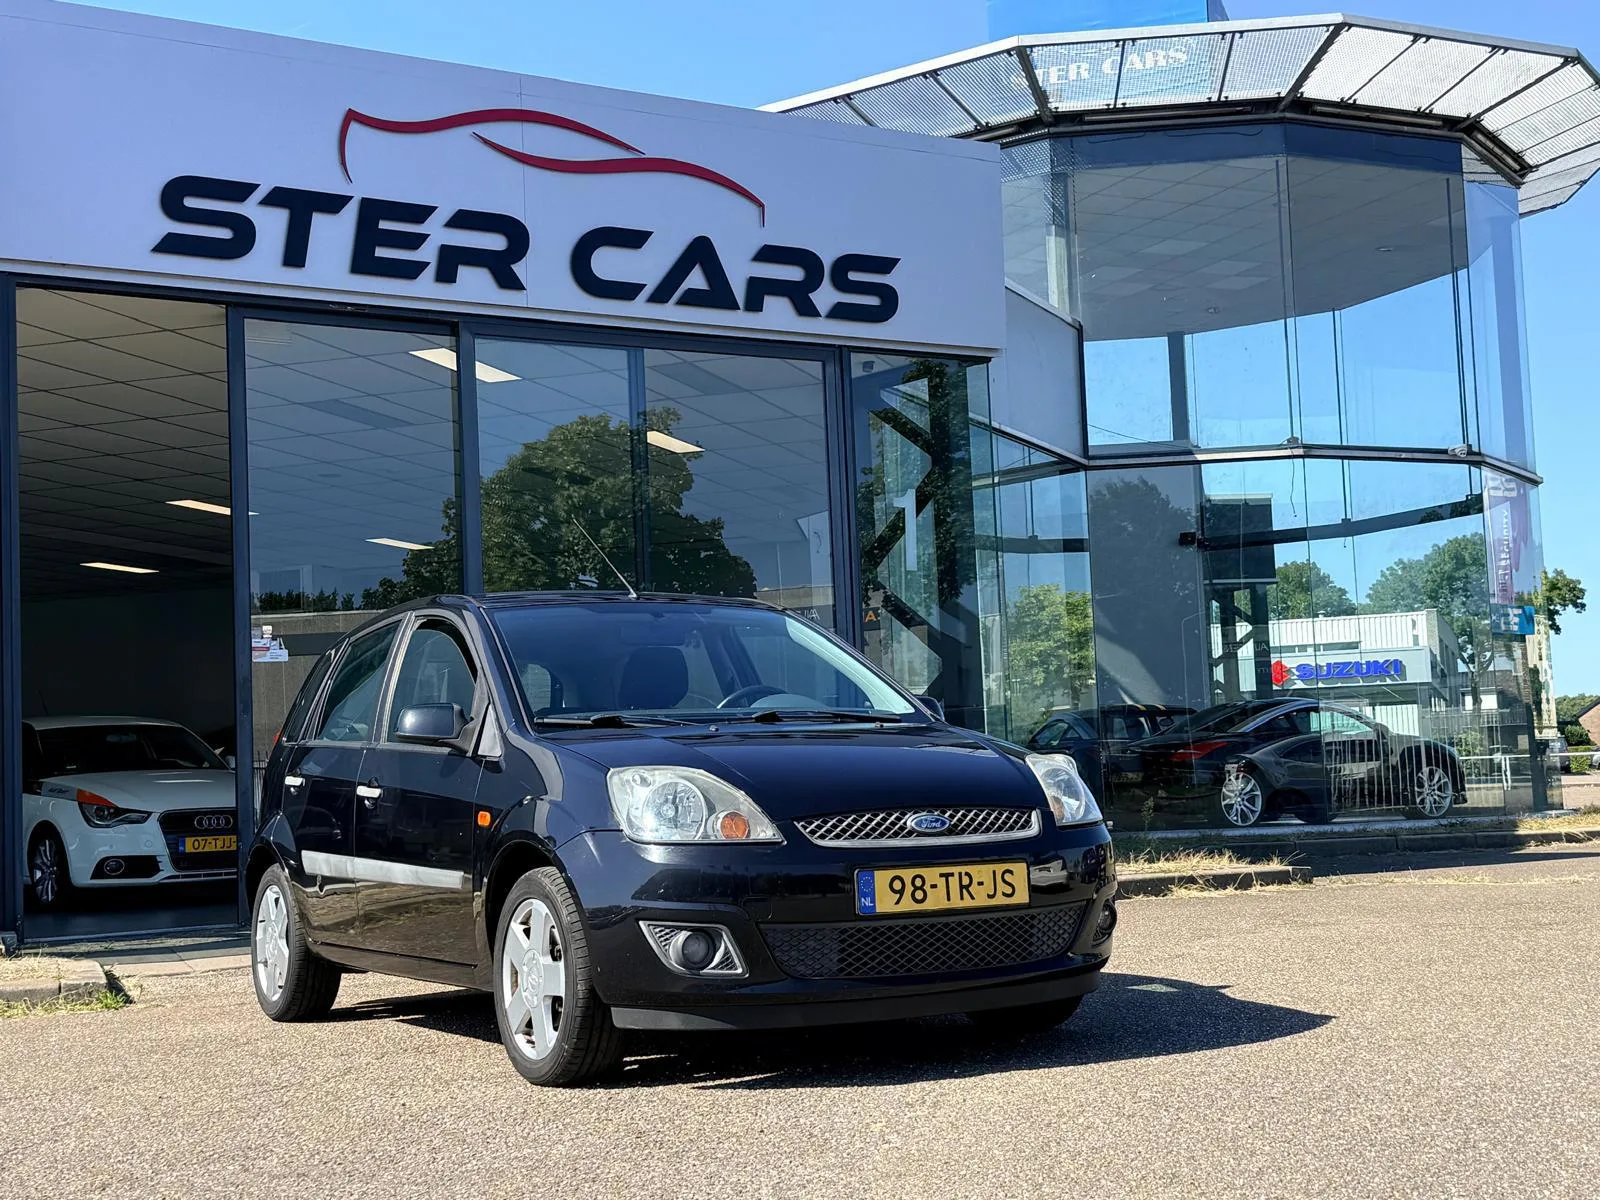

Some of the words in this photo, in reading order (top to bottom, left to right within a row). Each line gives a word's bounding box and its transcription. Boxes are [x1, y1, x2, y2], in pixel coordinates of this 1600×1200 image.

[1102, 45, 1188, 76] CARS
[150, 175, 530, 291] STER
[569, 226, 902, 323] CARS
[1295, 658, 1403, 680] SUZUKI
[921, 817, 942, 829] Ford
[192, 837, 237, 850] 07-TJJ-
[888, 868, 1017, 905] 98-TR-JS
[861, 895, 874, 907] NL
